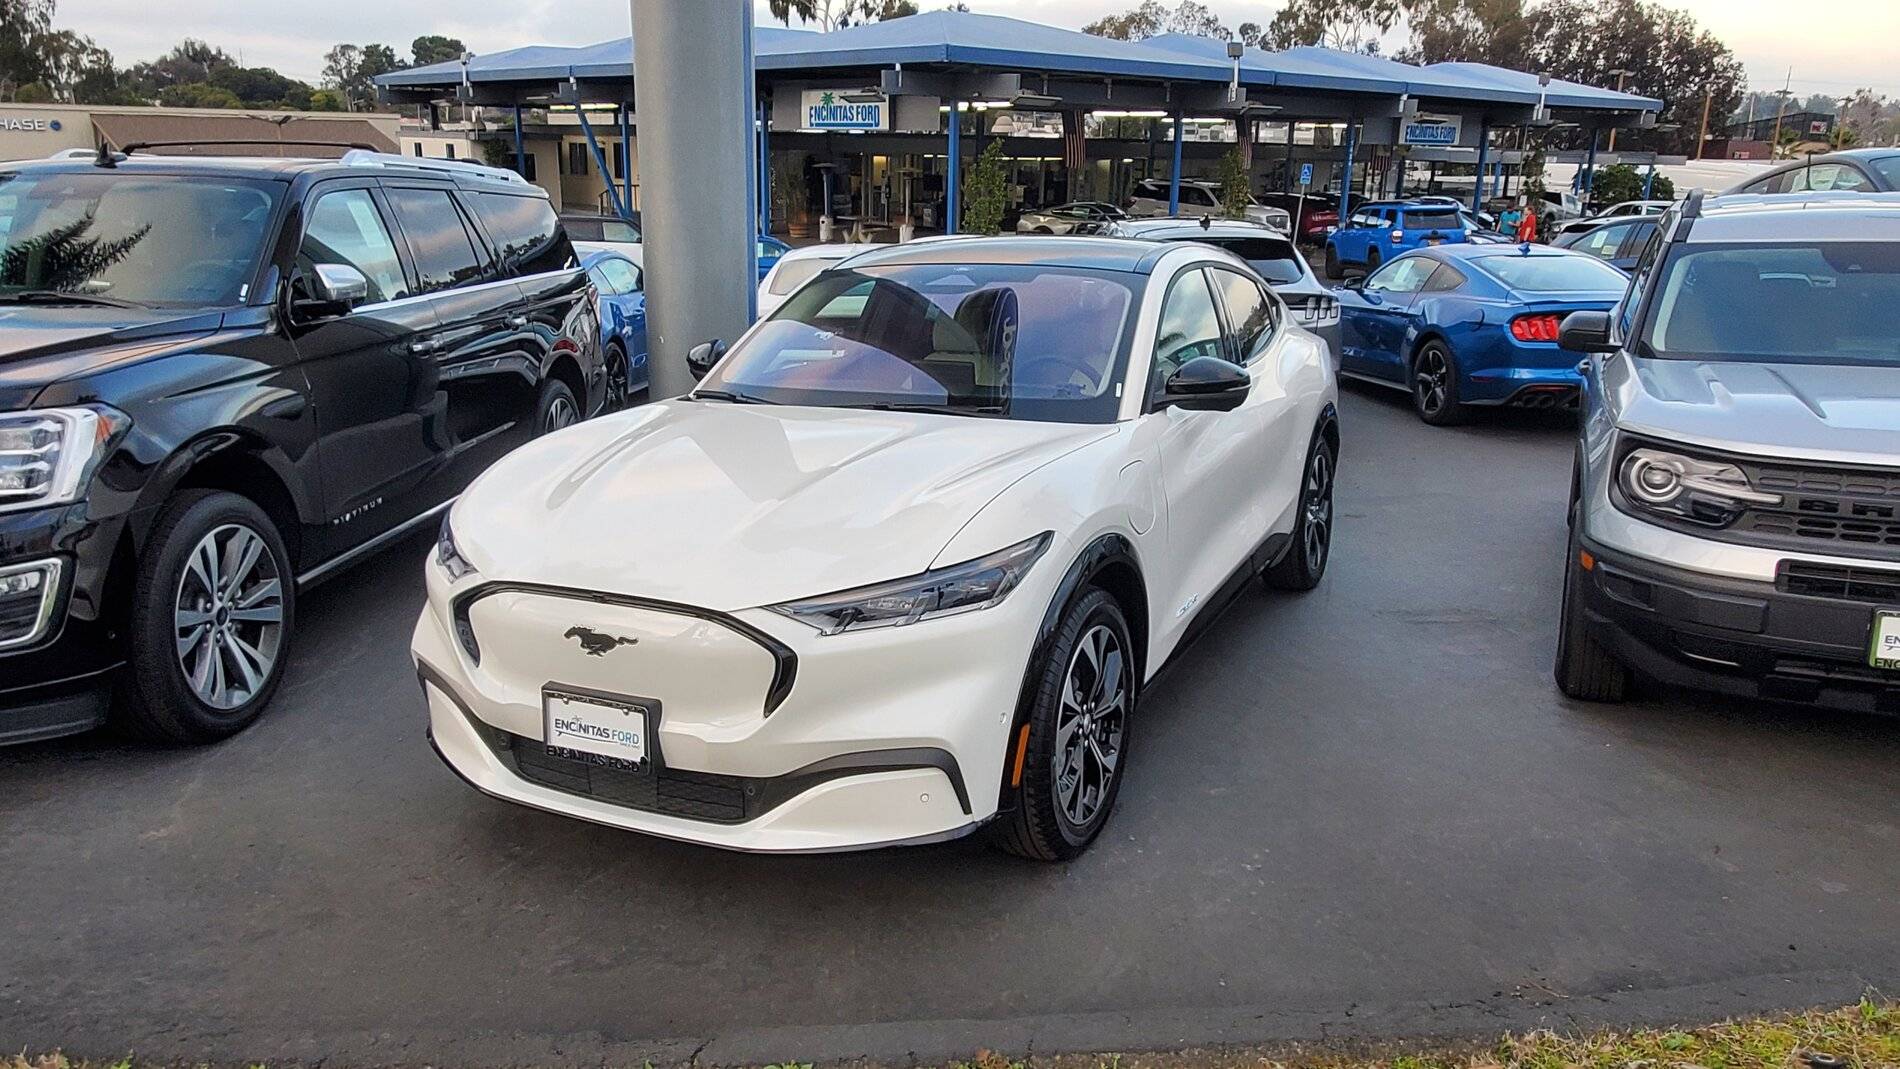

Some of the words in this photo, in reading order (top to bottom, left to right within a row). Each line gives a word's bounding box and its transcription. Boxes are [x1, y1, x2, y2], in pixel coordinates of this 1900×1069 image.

[809, 104, 854, 127] ENCINITAS
[856, 105, 881, 127] FORD
[554, 718, 610, 738] ENCINITAS
[611, 730, 640, 745] FORD
[546, 745, 606, 767] ENCINITAS
[608, 757, 640, 773] FORD
